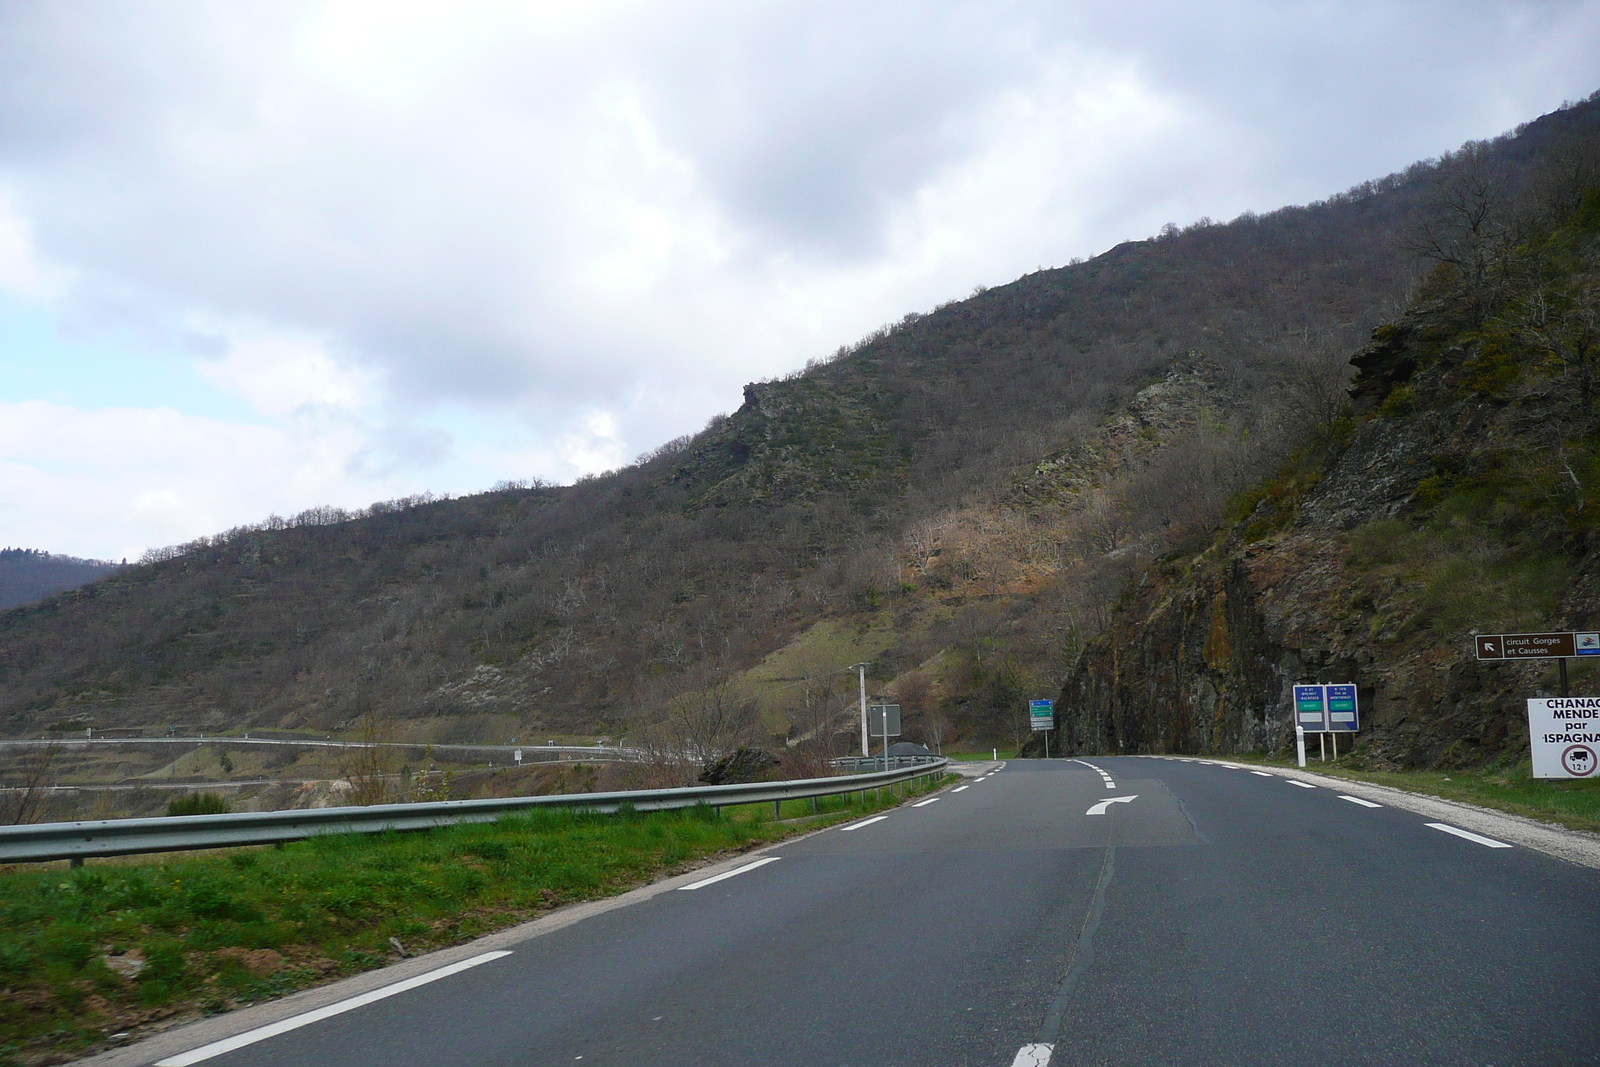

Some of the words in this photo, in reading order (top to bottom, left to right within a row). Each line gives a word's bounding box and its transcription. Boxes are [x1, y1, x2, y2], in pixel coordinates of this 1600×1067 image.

[1506, 638, 1530, 646] circuit
[1533, 637, 1561, 646] Gorges
[1518, 647, 1549, 655] Causses
[1553, 709, 1599, 719] MENDE
[1565, 722, 1588, 732] par
[1544, 733, 1600, 743] ISPAGNA
[1572, 763, 1582, 771] 12
